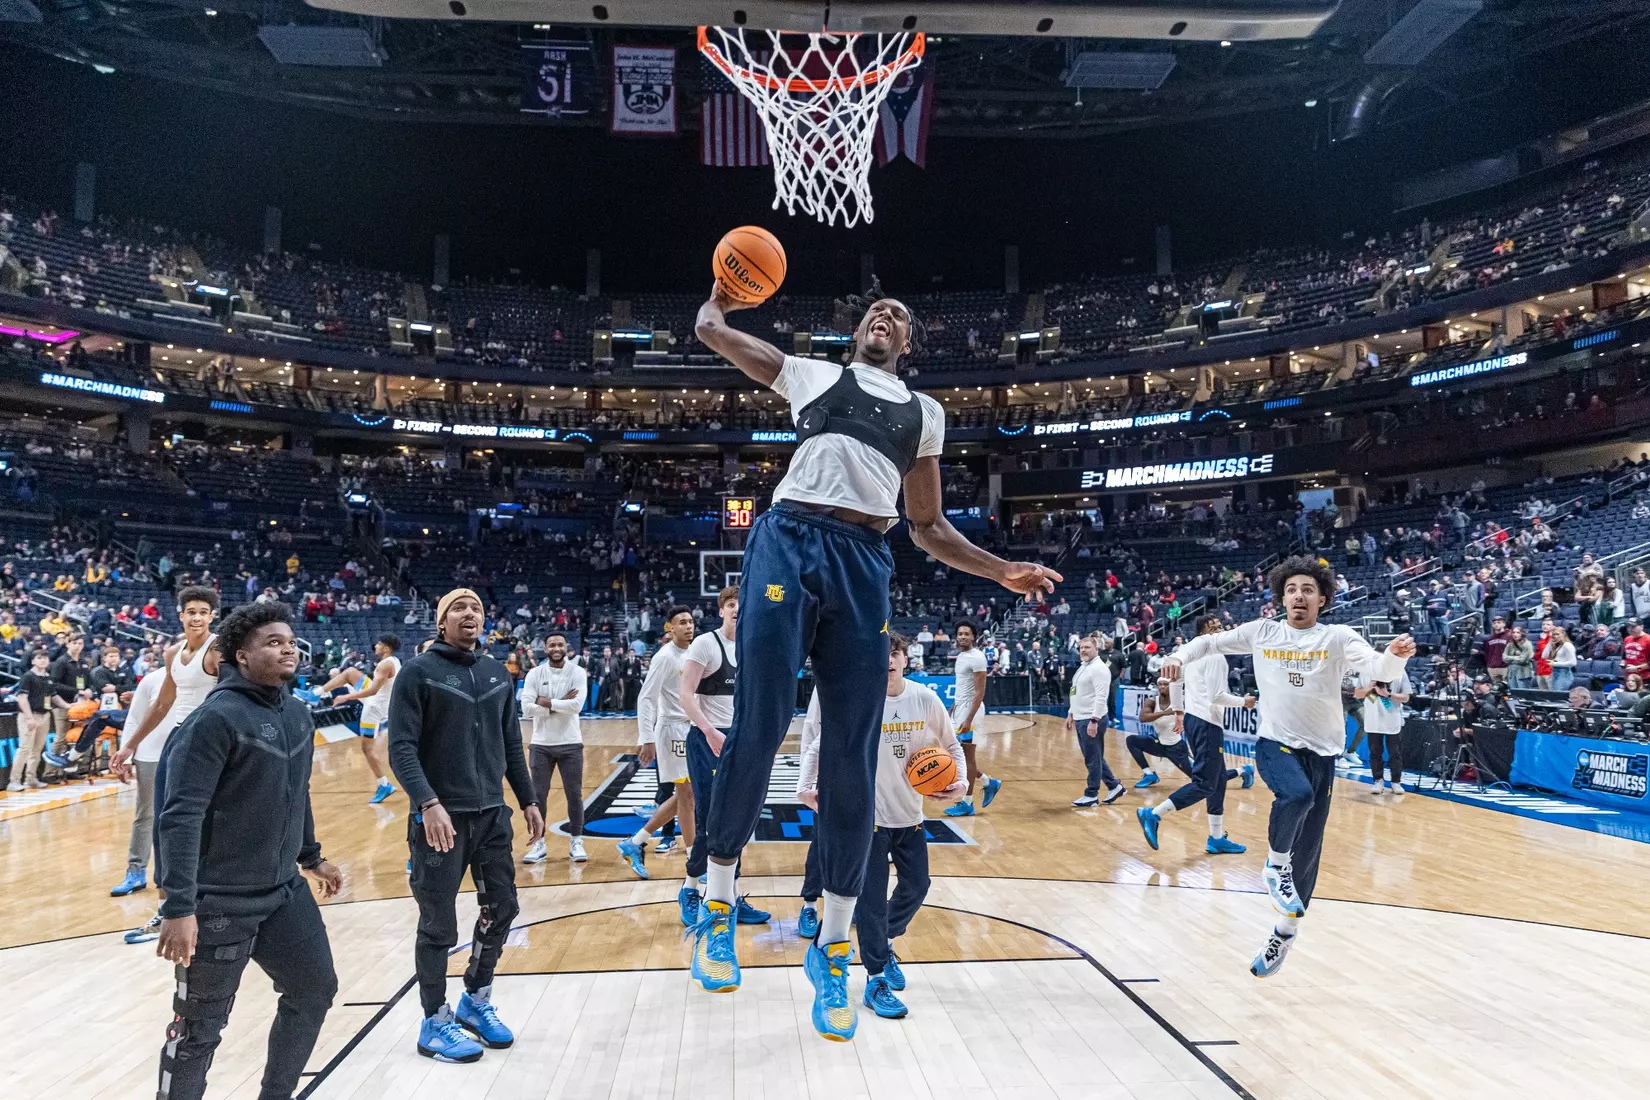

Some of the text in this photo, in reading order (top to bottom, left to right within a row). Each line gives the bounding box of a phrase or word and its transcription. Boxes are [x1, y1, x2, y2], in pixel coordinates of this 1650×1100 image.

[544, 51, 567, 61] NASH
[724, 252, 764, 293] Wilson
[1411, 352, 1528, 386] #MARCHMADNESS
[41, 373, 165, 403] #MARCHMADNESS
[407, 421, 442, 433] FIRST
[453, 424, 497, 437] SECOND
[499, 426, 544, 439] ROUNDS
[1046, 422, 1079, 434] FIRST
[1090, 418, 1133, 430] SECOND
[1135, 413, 1179, 427] ROUNDS
[752, 432, 797, 442] #MARCH
[730, 509, 750, 526] 30
[1263, 649, 1329, 661] MARQUETTE
[1280, 660, 1312, 671] SOLE
[882, 721, 925, 732] RQUETTE
[1223, 706, 1258, 735] UNDS
[885, 731, 912, 743] SOLE
[916, 759, 940, 778] NCAA
[1590, 754, 1628, 773] MARCH
[1593, 771, 1646, 792] MADNESS
